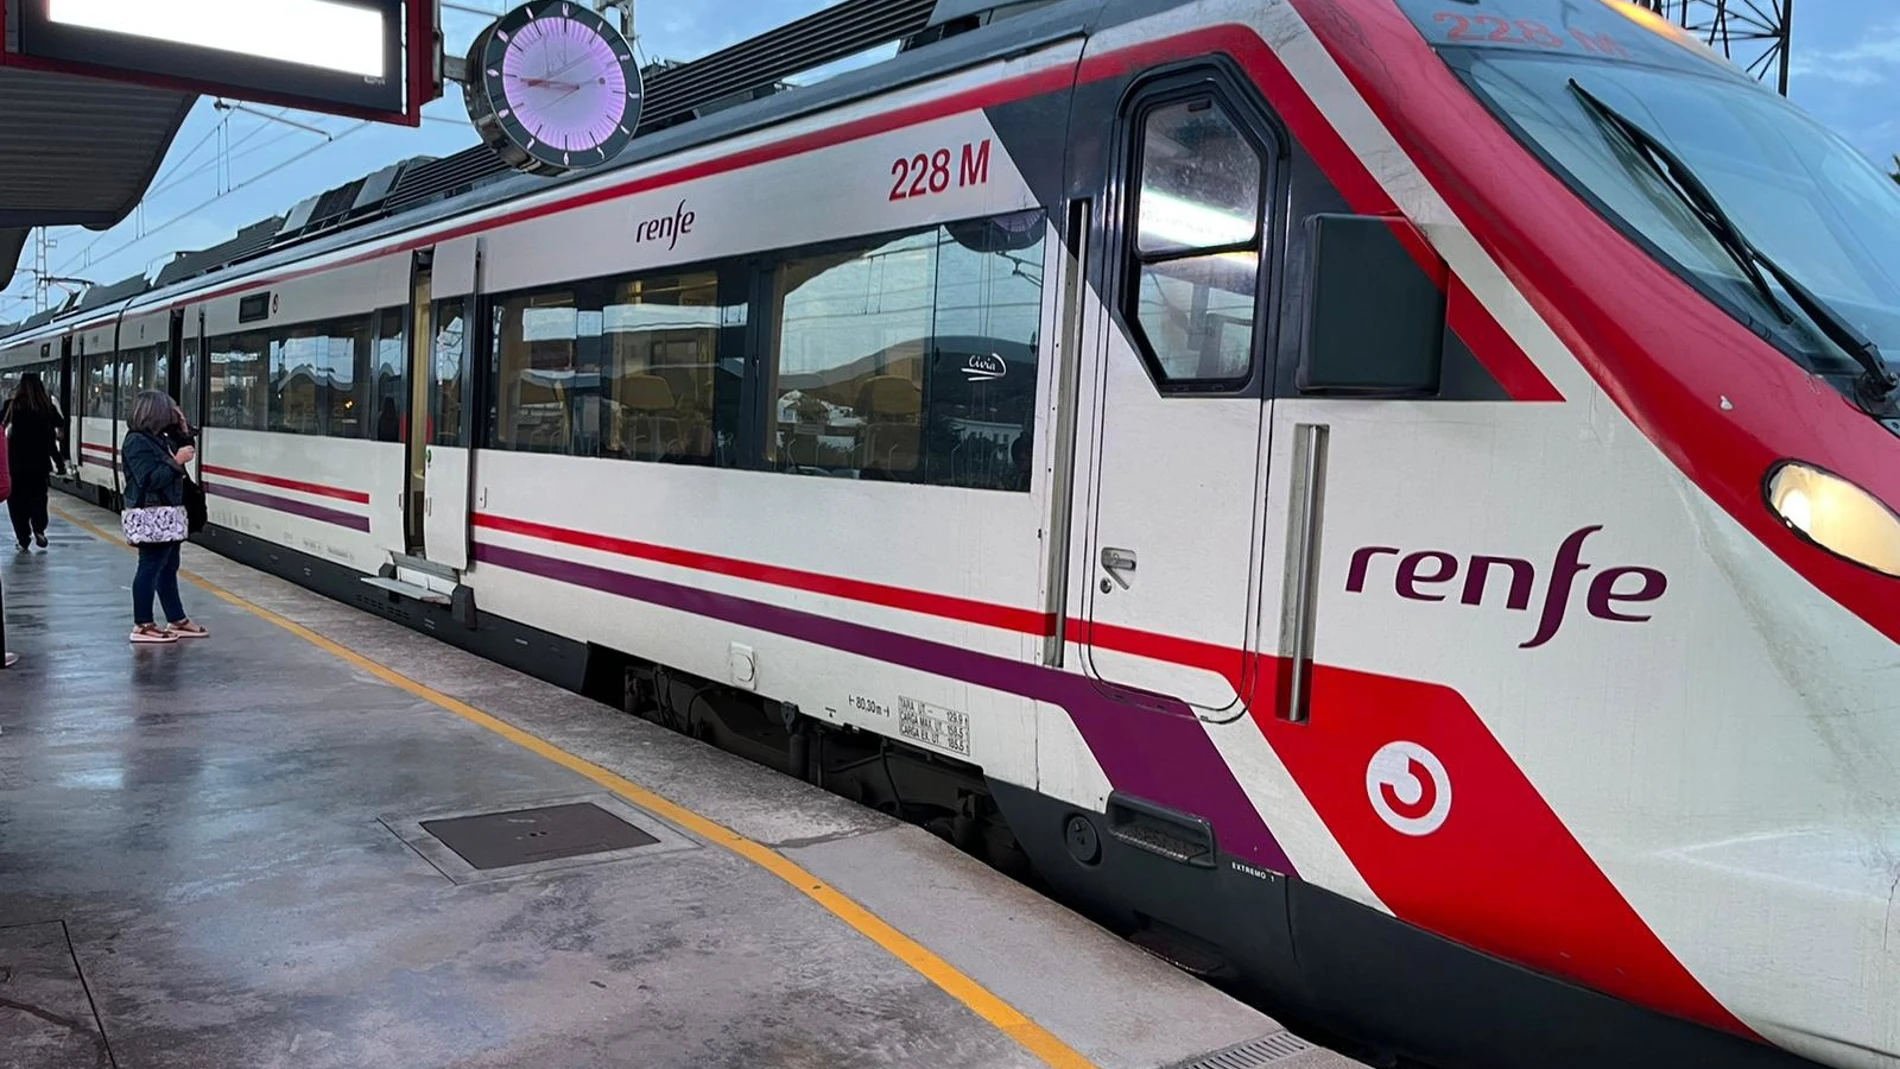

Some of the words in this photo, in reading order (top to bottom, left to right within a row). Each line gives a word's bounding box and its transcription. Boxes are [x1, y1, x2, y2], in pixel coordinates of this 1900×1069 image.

[1433, 12, 1564, 48] 228
[1568, 26, 1630, 58] M
[889, 148, 951, 202] 228
[959, 139, 991, 187] M
[635, 198, 696, 251] renfe
[968, 354, 996, 371] Civia
[1345, 524, 1668, 649] renfe
[900, 710, 918, 725] CARGA
[1232, 861, 1266, 879] EXTREMO
